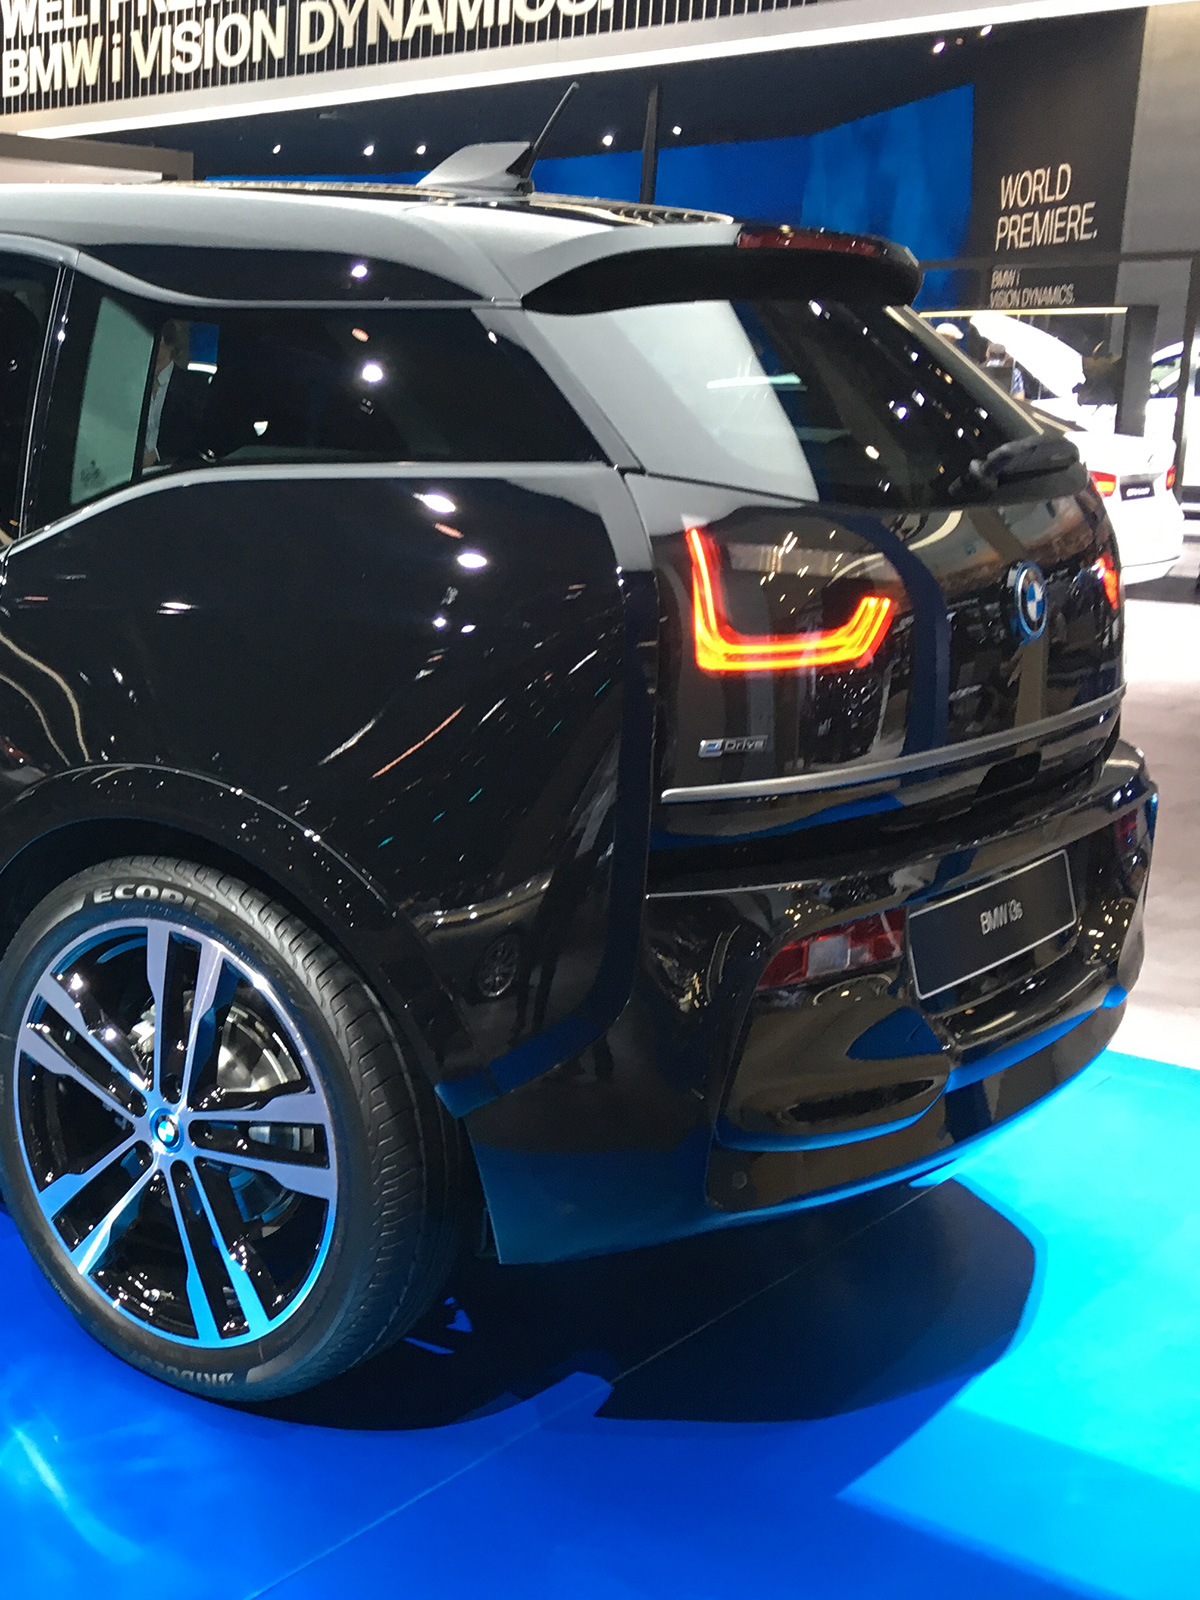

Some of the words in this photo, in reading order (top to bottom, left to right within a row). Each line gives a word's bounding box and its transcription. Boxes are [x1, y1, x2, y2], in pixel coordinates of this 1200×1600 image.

[2, 36, 103, 98] BMW
[112, 32, 121, 83] i
[130, 5, 286, 80] VISION
[1001, 163, 1072, 211] WORLD
[995, 201, 1098, 252] PREMIERE.
[989, 288, 1021, 309] VISION
[991, 270, 1016, 289] BMW
[980, 903, 1008, 935] BMW
